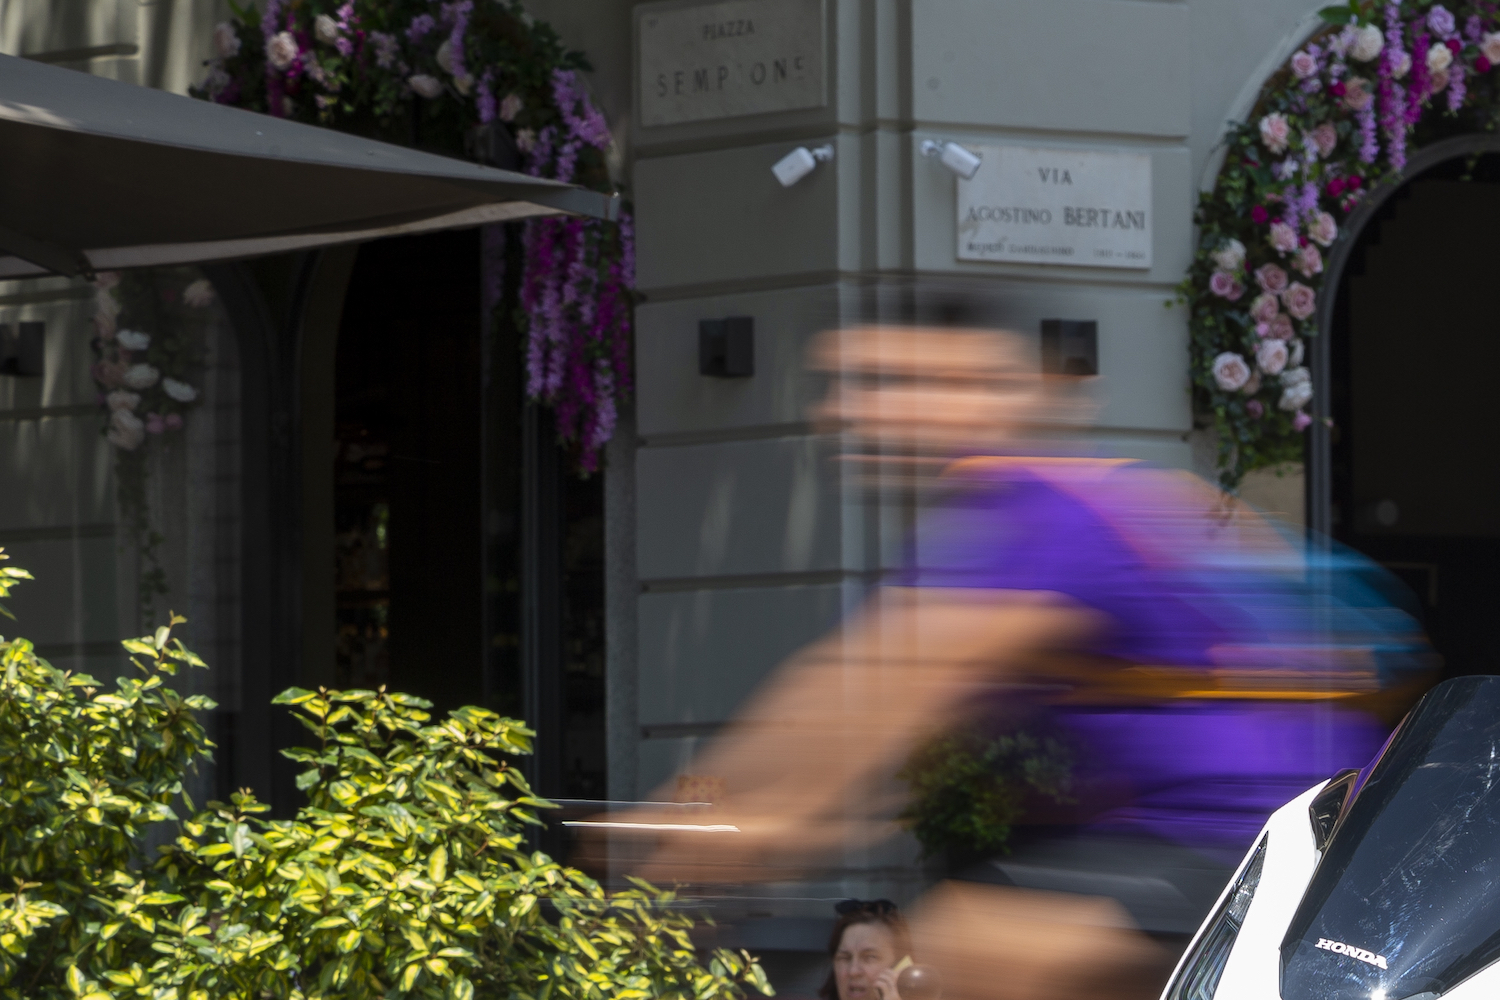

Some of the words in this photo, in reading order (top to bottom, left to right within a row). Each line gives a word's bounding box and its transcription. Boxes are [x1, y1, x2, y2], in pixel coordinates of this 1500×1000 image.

[702, 18, 755, 41] PIAZZA
[656, 55, 804, 98] SEMPONE
[1037, 166, 1074, 186] VIA
[967, 205, 1053, 225] AGOSTINO
[1063, 205, 1146, 230] BERTANI
[1314, 937, 1388, 970] HONDA
